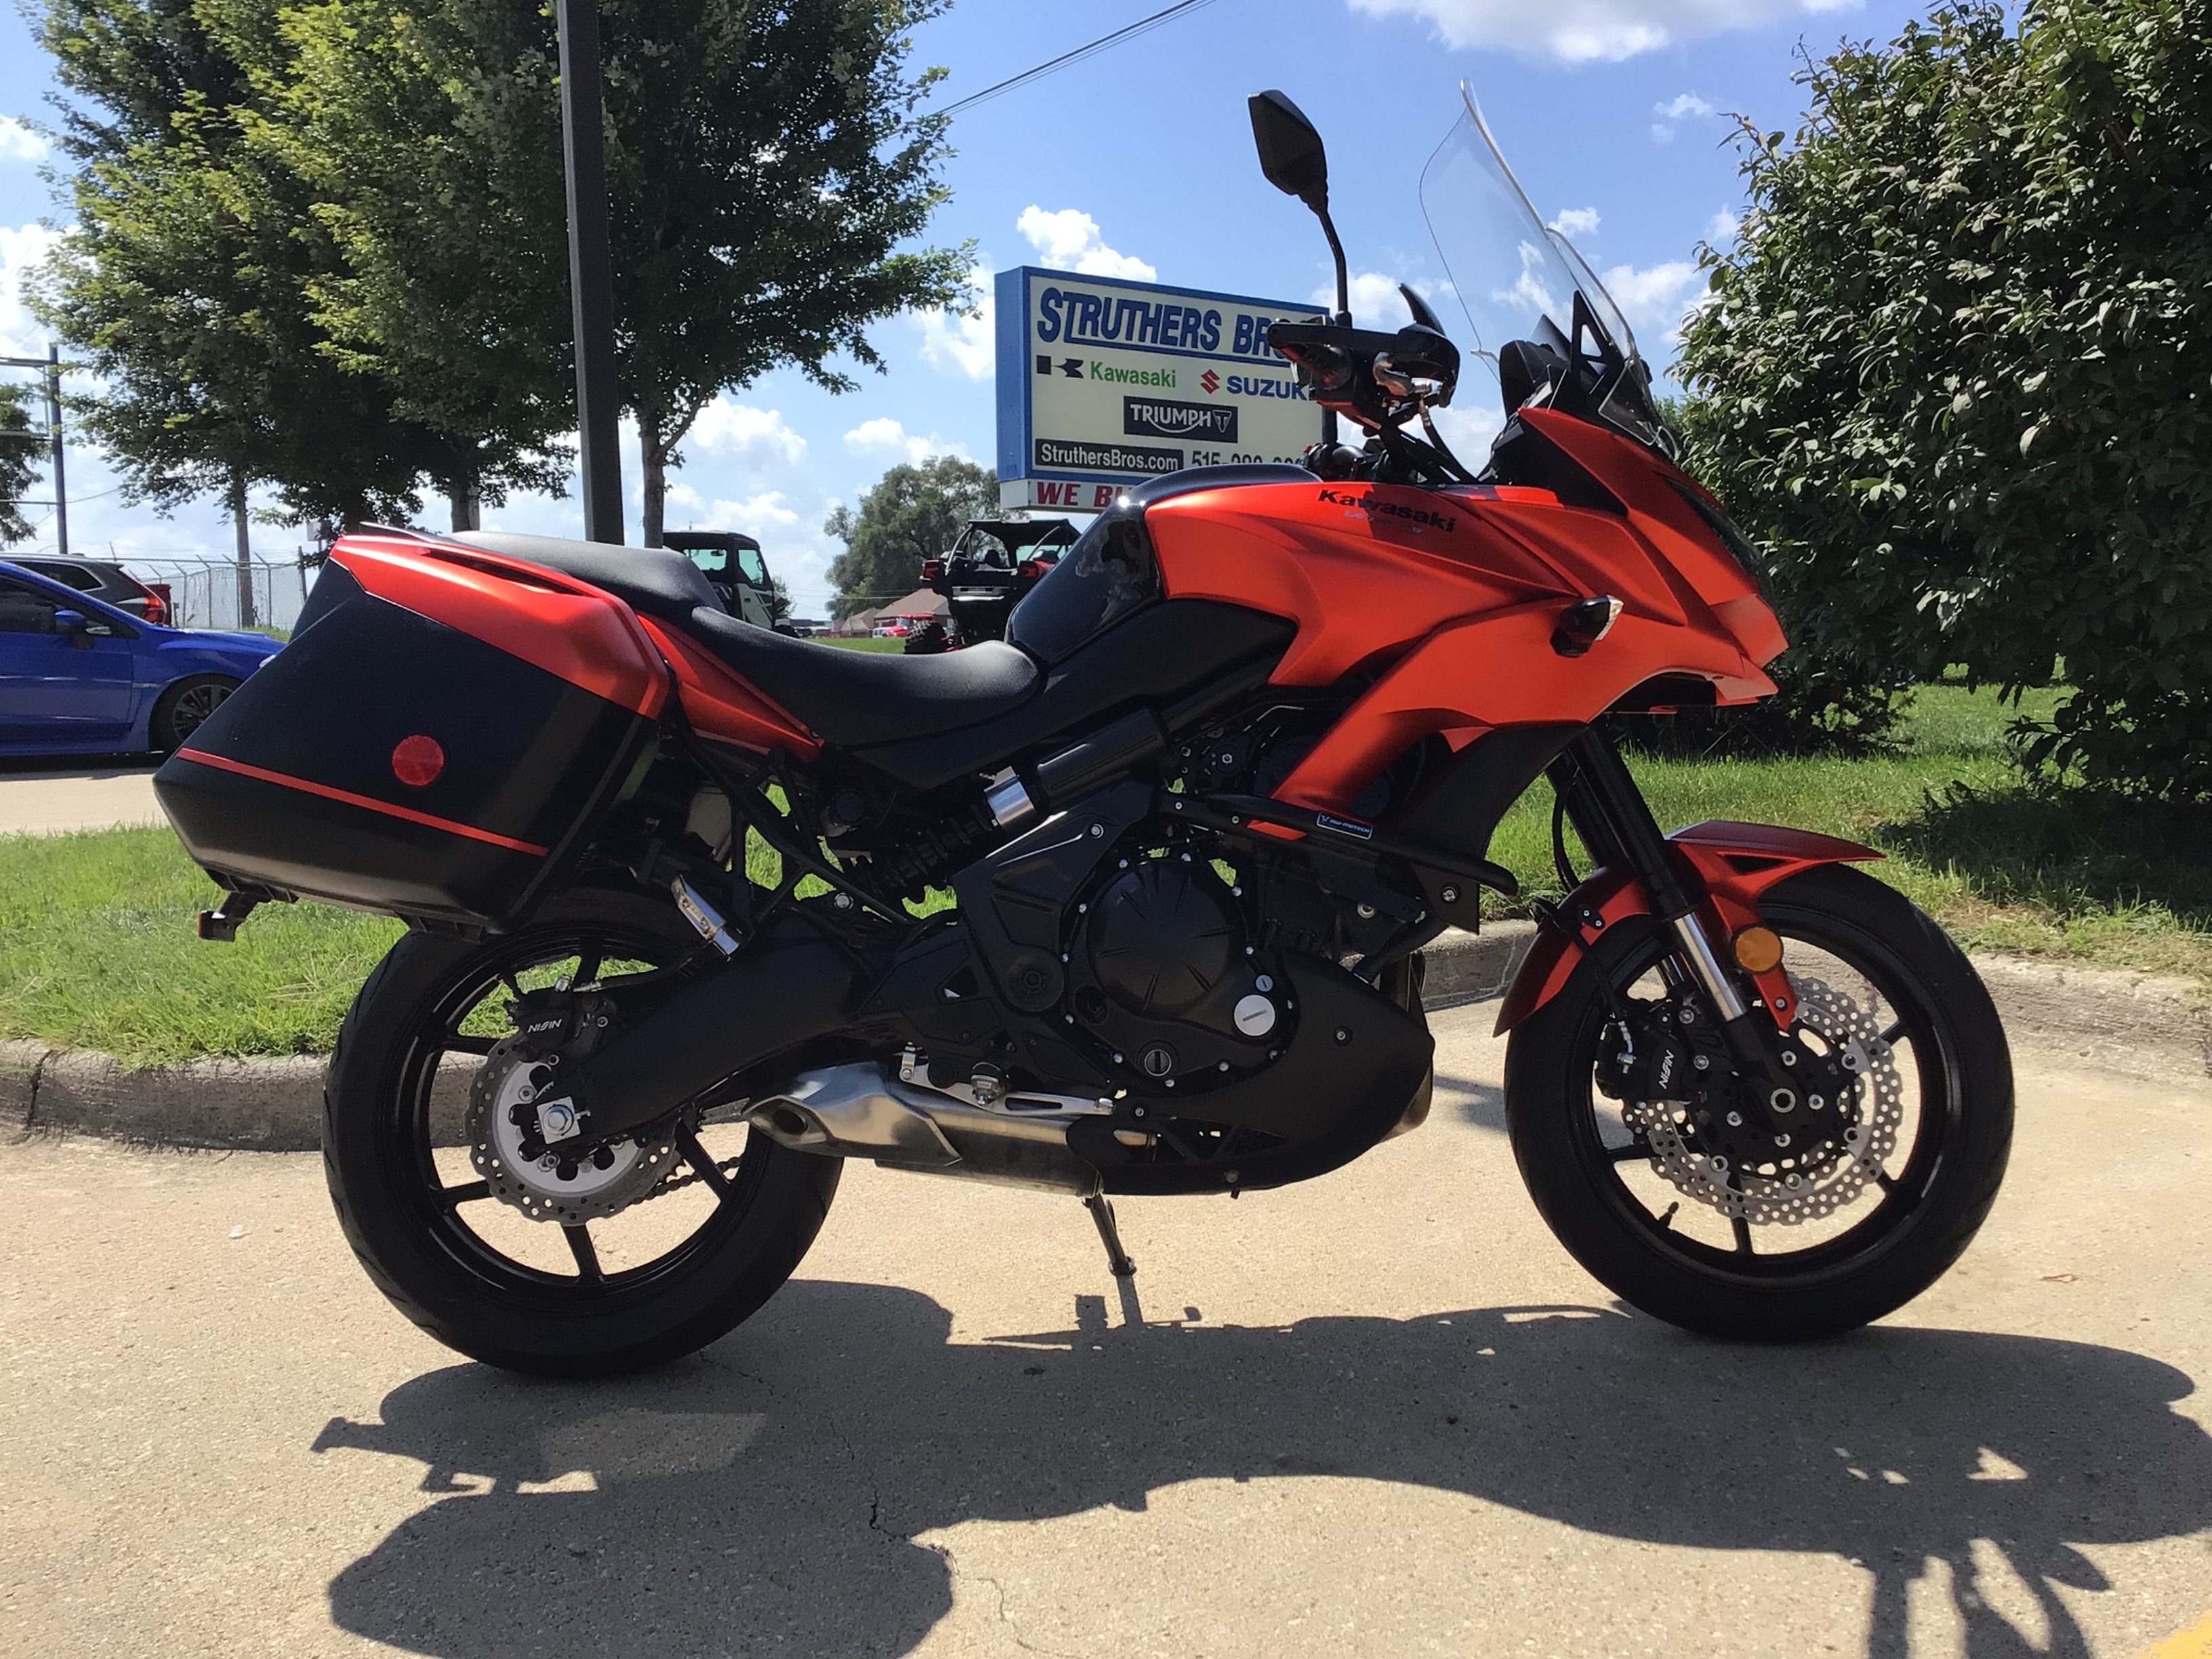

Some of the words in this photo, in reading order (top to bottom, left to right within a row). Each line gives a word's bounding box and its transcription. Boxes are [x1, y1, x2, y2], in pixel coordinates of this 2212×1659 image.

[1037, 287, 1222, 351] STRUTHERS
[1233, 314, 1307, 359] BR
[1090, 361, 1176, 388] Kawasaki
[1227, 375, 1307, 401] SUZUK
[1130, 404, 1212, 433] TRIUMPH
[1041, 443, 1179, 471] StruthersBros.com
[1037, 482, 1081, 506] WE
[1318, 489, 1456, 533] Kawasaki
[527, 1019, 562, 1033] NISSIN
[1659, 1049, 1675, 1090] NISSIN
